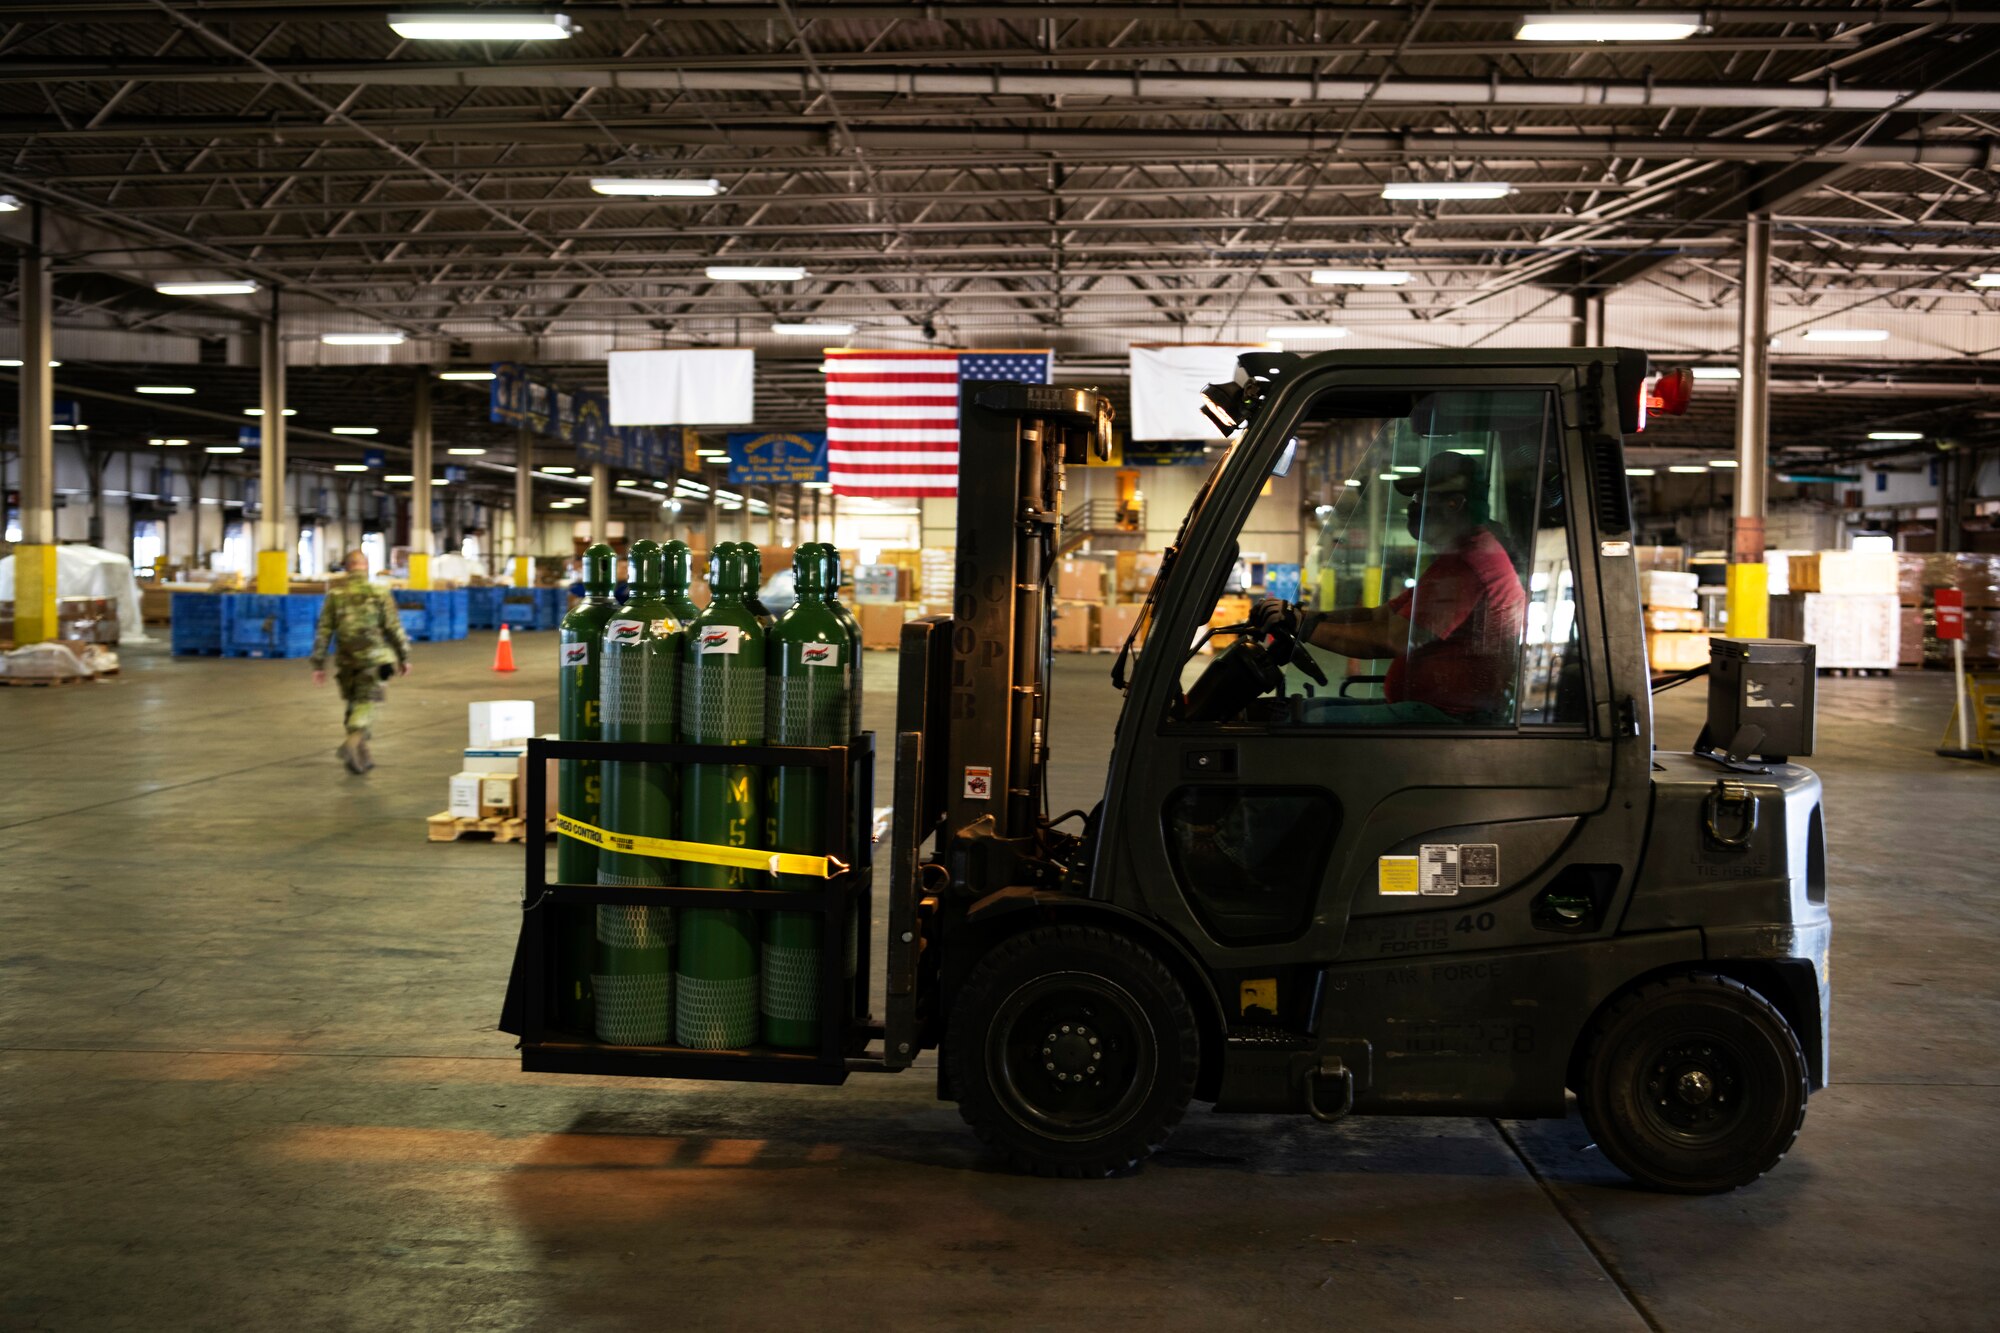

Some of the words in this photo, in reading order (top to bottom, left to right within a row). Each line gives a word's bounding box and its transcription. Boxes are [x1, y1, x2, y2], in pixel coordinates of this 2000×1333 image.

[573, 824, 604, 844] CONTROL
[1696, 865, 1719, 877] TIE
[1723, 865, 1763, 877] HERE
[1454, 911, 1496, 934] 40
[1379, 938, 1450, 954] FORTIS
[1385, 970, 1419, 985] AIR
[1431, 962, 1504, 982] FORCE
